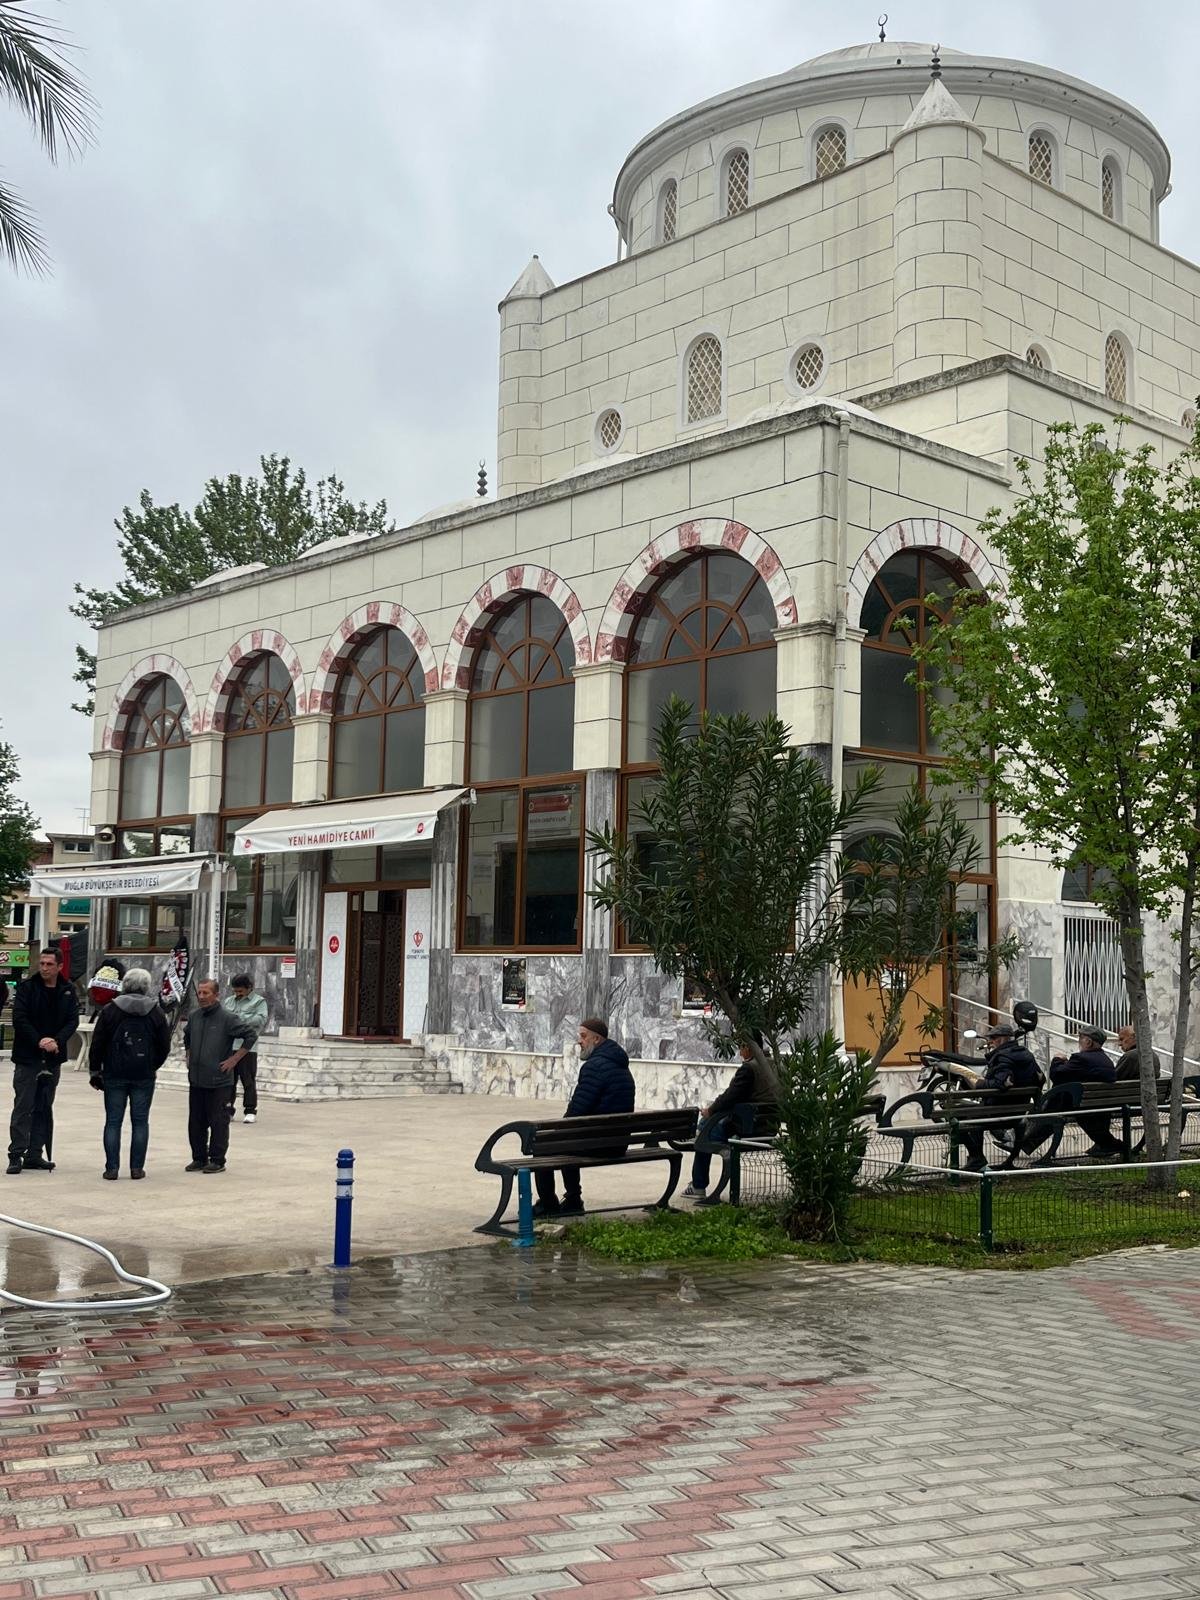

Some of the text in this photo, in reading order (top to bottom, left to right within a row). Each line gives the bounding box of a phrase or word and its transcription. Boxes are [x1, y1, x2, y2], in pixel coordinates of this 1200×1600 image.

[288, 827, 375, 846] YENİ HAMİDİYE CAMİİ
[64, 875, 160, 891] MUĞLA BÜYÜKŞEHİR BELEDİYESİ
